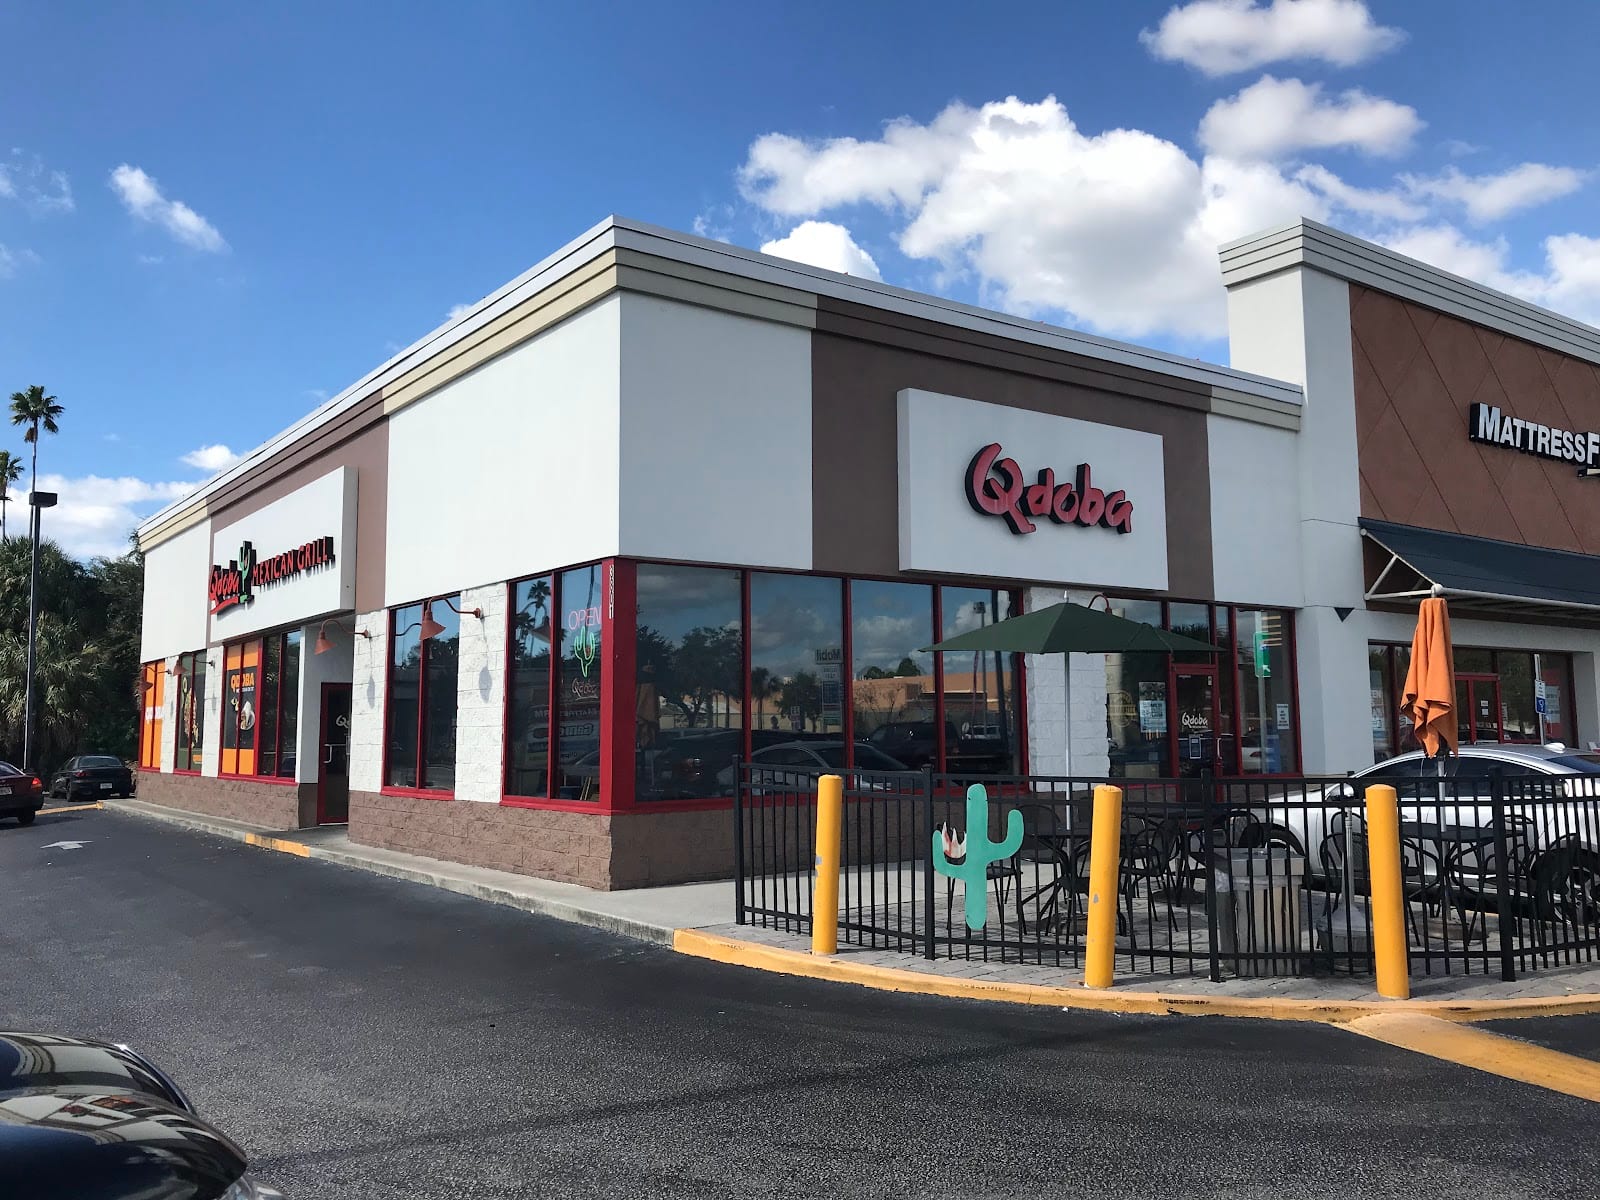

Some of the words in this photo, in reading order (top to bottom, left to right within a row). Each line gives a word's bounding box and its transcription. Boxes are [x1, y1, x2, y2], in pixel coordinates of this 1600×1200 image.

[965, 443, 1134, 534] Qdoba
[252, 548, 297, 586] MEXICAN
[296, 536, 334, 570] GRILL
[568, 606, 602, 630] OPEN
[1181, 711, 1208, 729] Qdoba
